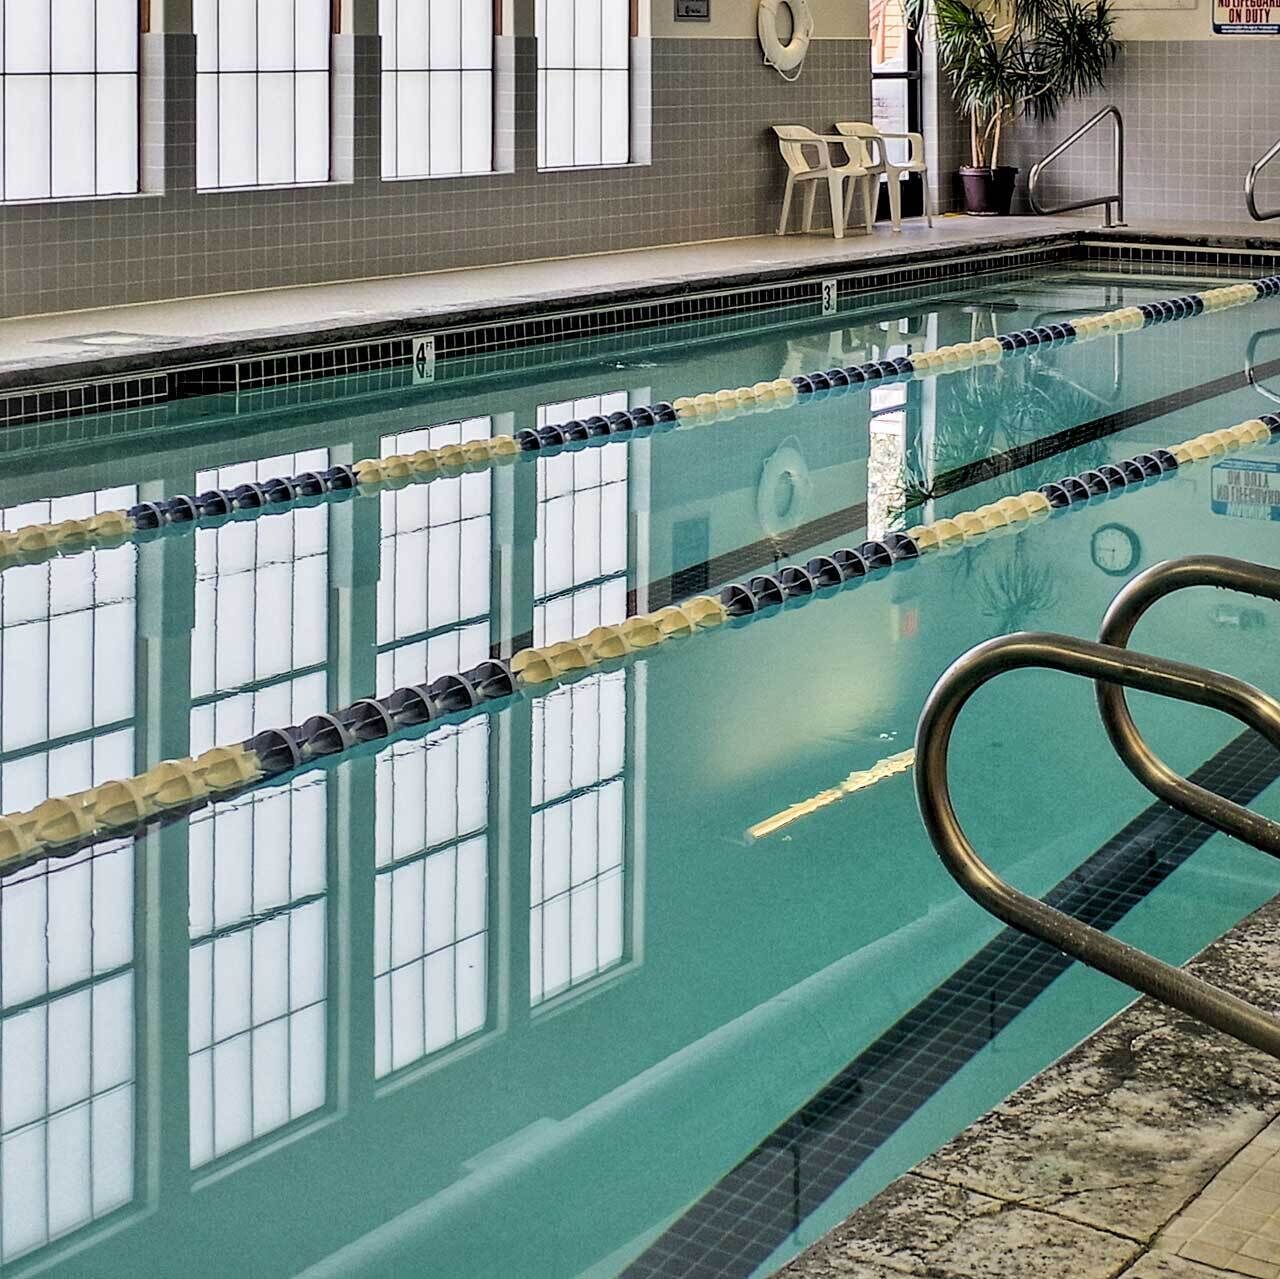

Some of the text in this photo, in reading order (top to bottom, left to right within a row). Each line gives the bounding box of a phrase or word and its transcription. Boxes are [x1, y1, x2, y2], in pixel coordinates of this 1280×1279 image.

[1229, 9, 1270, 23] ON DUTY
[824, 284, 831, 301] 3
[416, 342, 426, 361] 4
